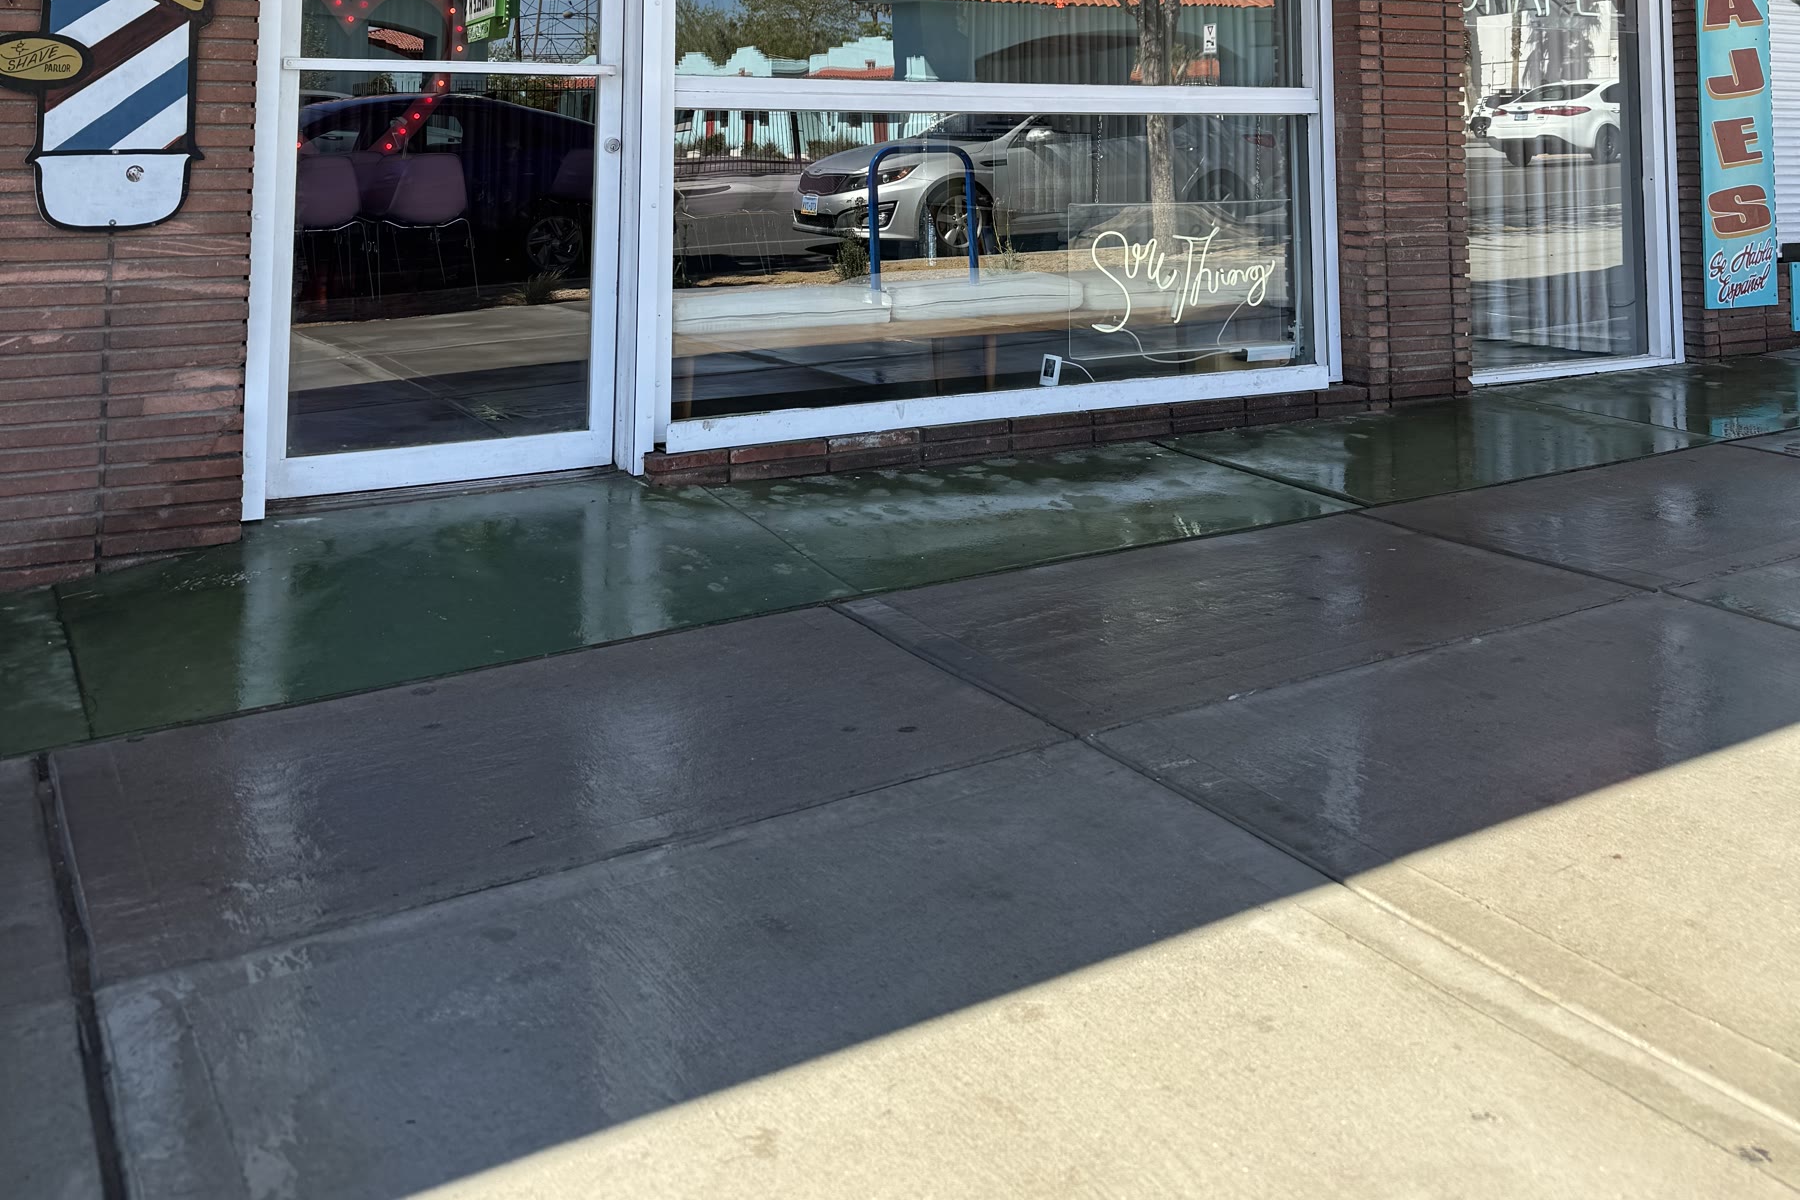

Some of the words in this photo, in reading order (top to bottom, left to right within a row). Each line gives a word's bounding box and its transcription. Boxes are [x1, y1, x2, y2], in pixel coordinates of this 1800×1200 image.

[8, 46, 59, 71] SHAVE
[44, 63, 71, 73] PARLOR
[1709, 248, 1727, 279] Se
[1730, 237, 1774, 273] Habla
[1092, 231, 1177, 333] Sure
[1173, 227, 1275, 323] Thing
[1717, 262, 1771, 308] Español
